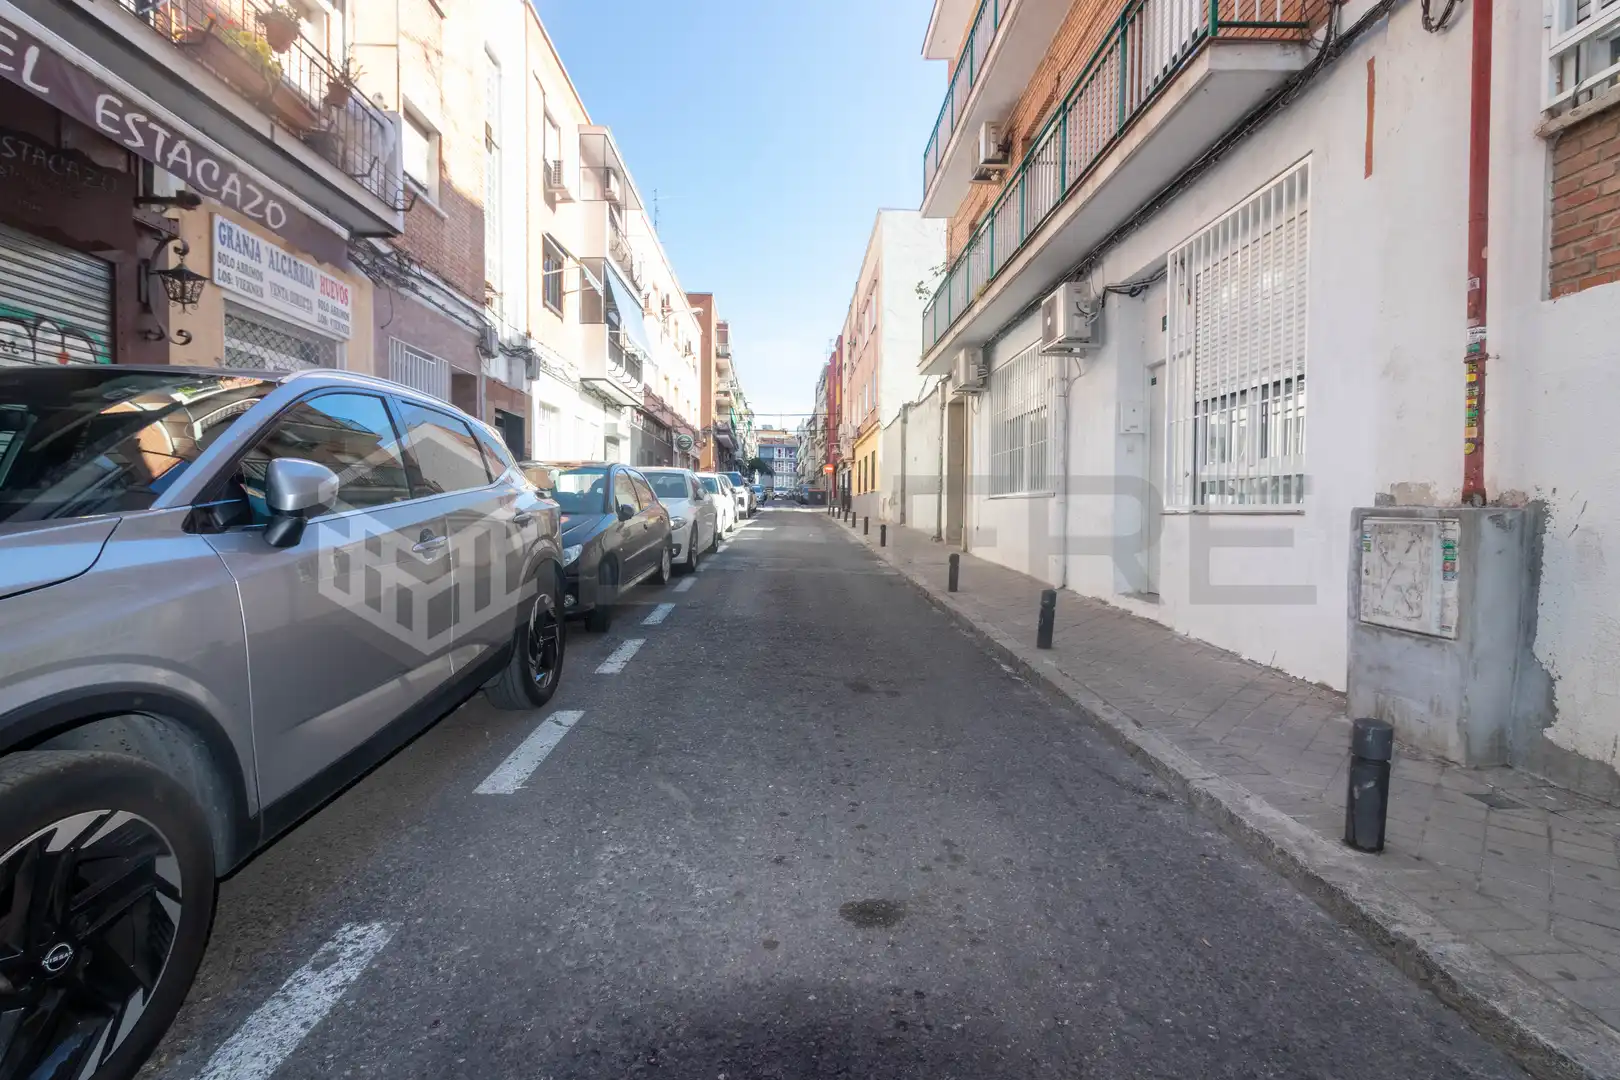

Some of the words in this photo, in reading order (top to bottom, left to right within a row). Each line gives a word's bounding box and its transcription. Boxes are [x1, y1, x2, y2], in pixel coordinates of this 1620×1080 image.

[0, 24, 49, 93] EL
[95, 93, 287, 229] ESTACAZO
[1, 135, 118, 193] STACAZO
[217, 251, 235, 269] SOLO
[218, 221, 262, 264] GRANJA
[320, 274, 348, 306] HUEVOS
[42, 949, 73, 965] NISSAN
